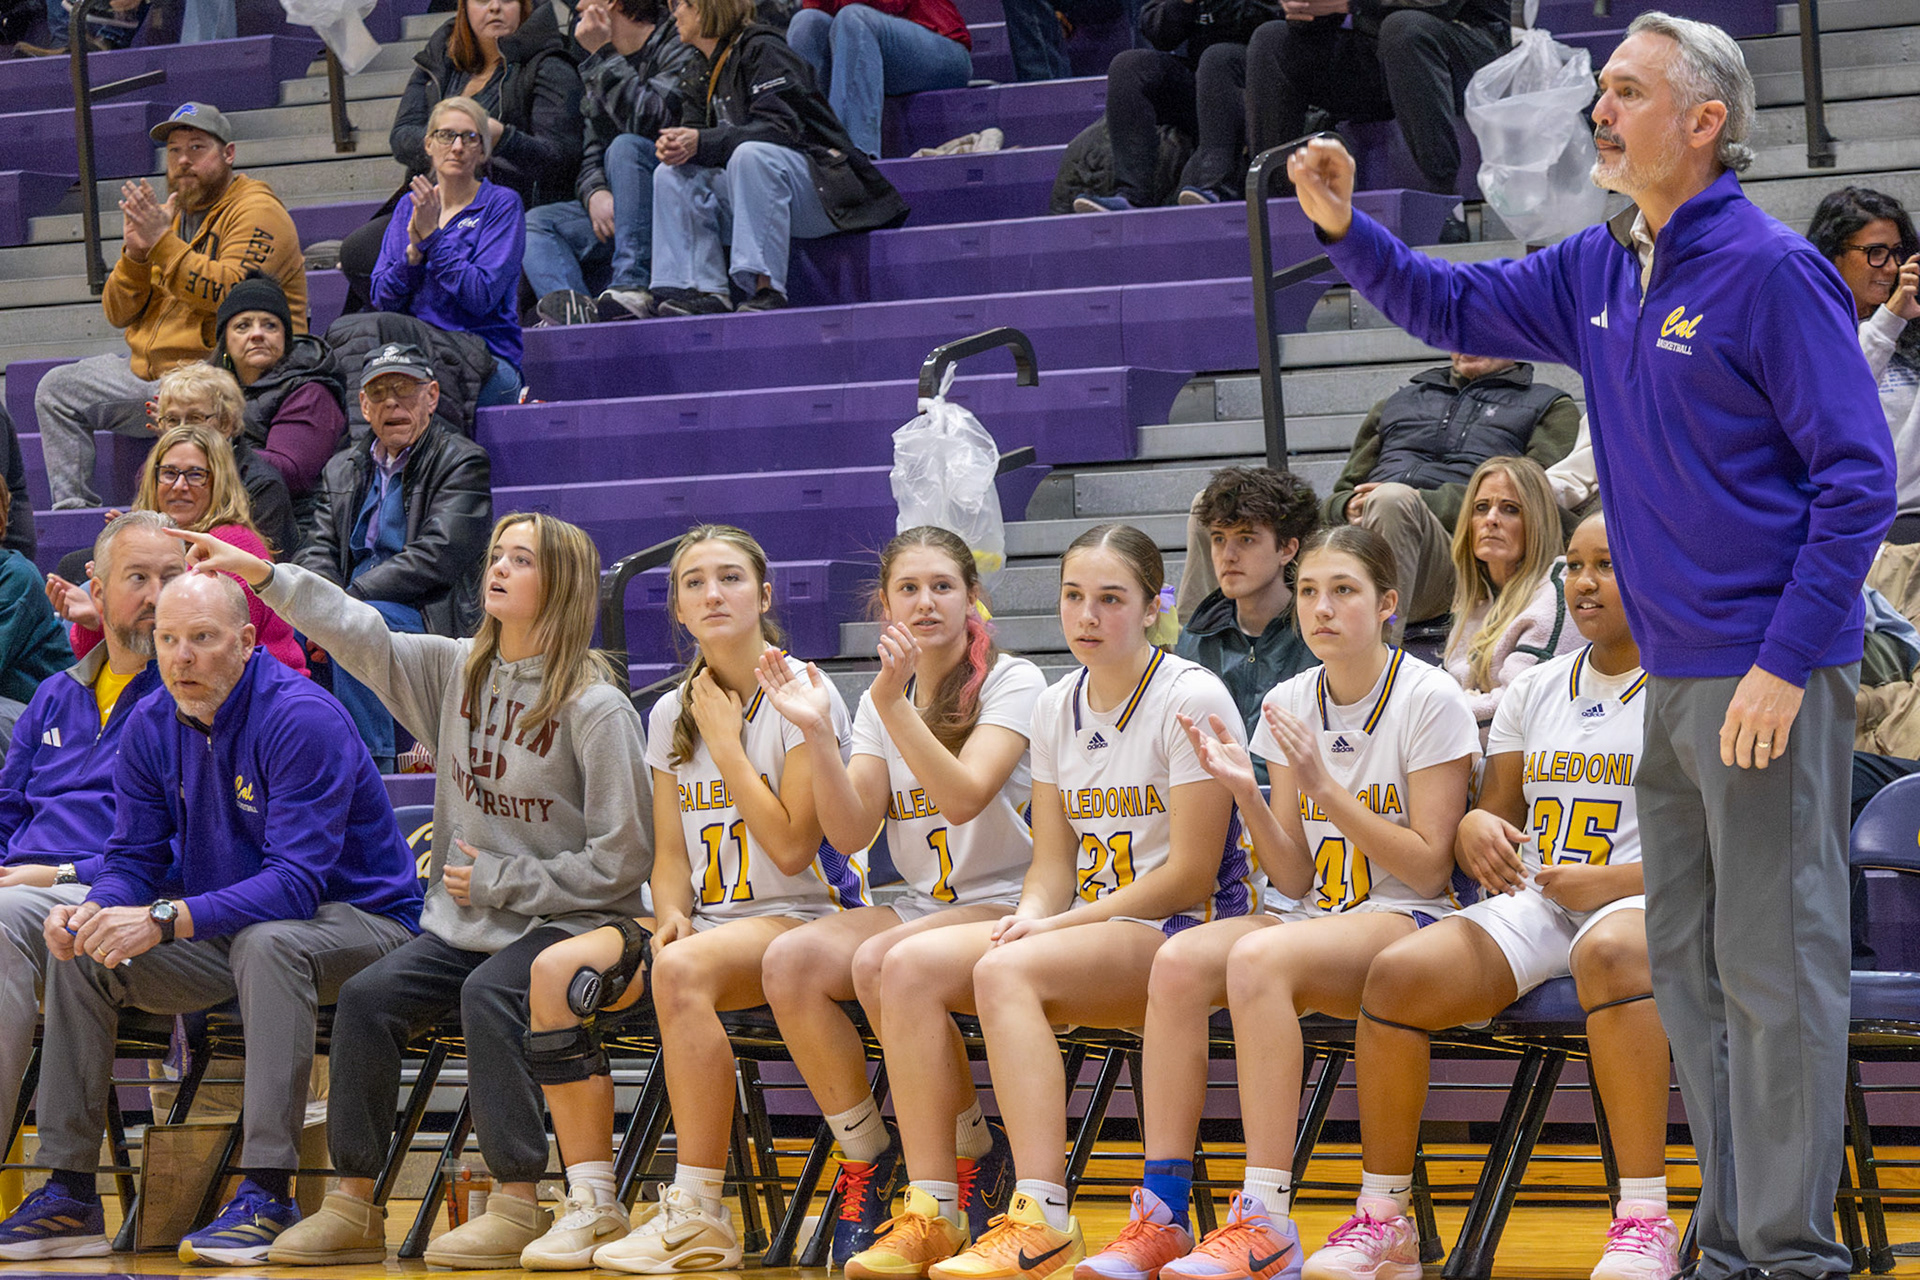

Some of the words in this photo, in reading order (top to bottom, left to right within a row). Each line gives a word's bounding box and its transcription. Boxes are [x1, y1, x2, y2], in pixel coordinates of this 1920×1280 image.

[1661, 305, 1704, 339] Cal
[235, 775, 254, 801] Cal
[1522, 750, 1635, 787] ALEDONI
[700, 818, 754, 906] 11
[926, 826, 959, 904] 1
[1533, 797, 1622, 866] 35
[1078, 831, 1136, 903] 21
